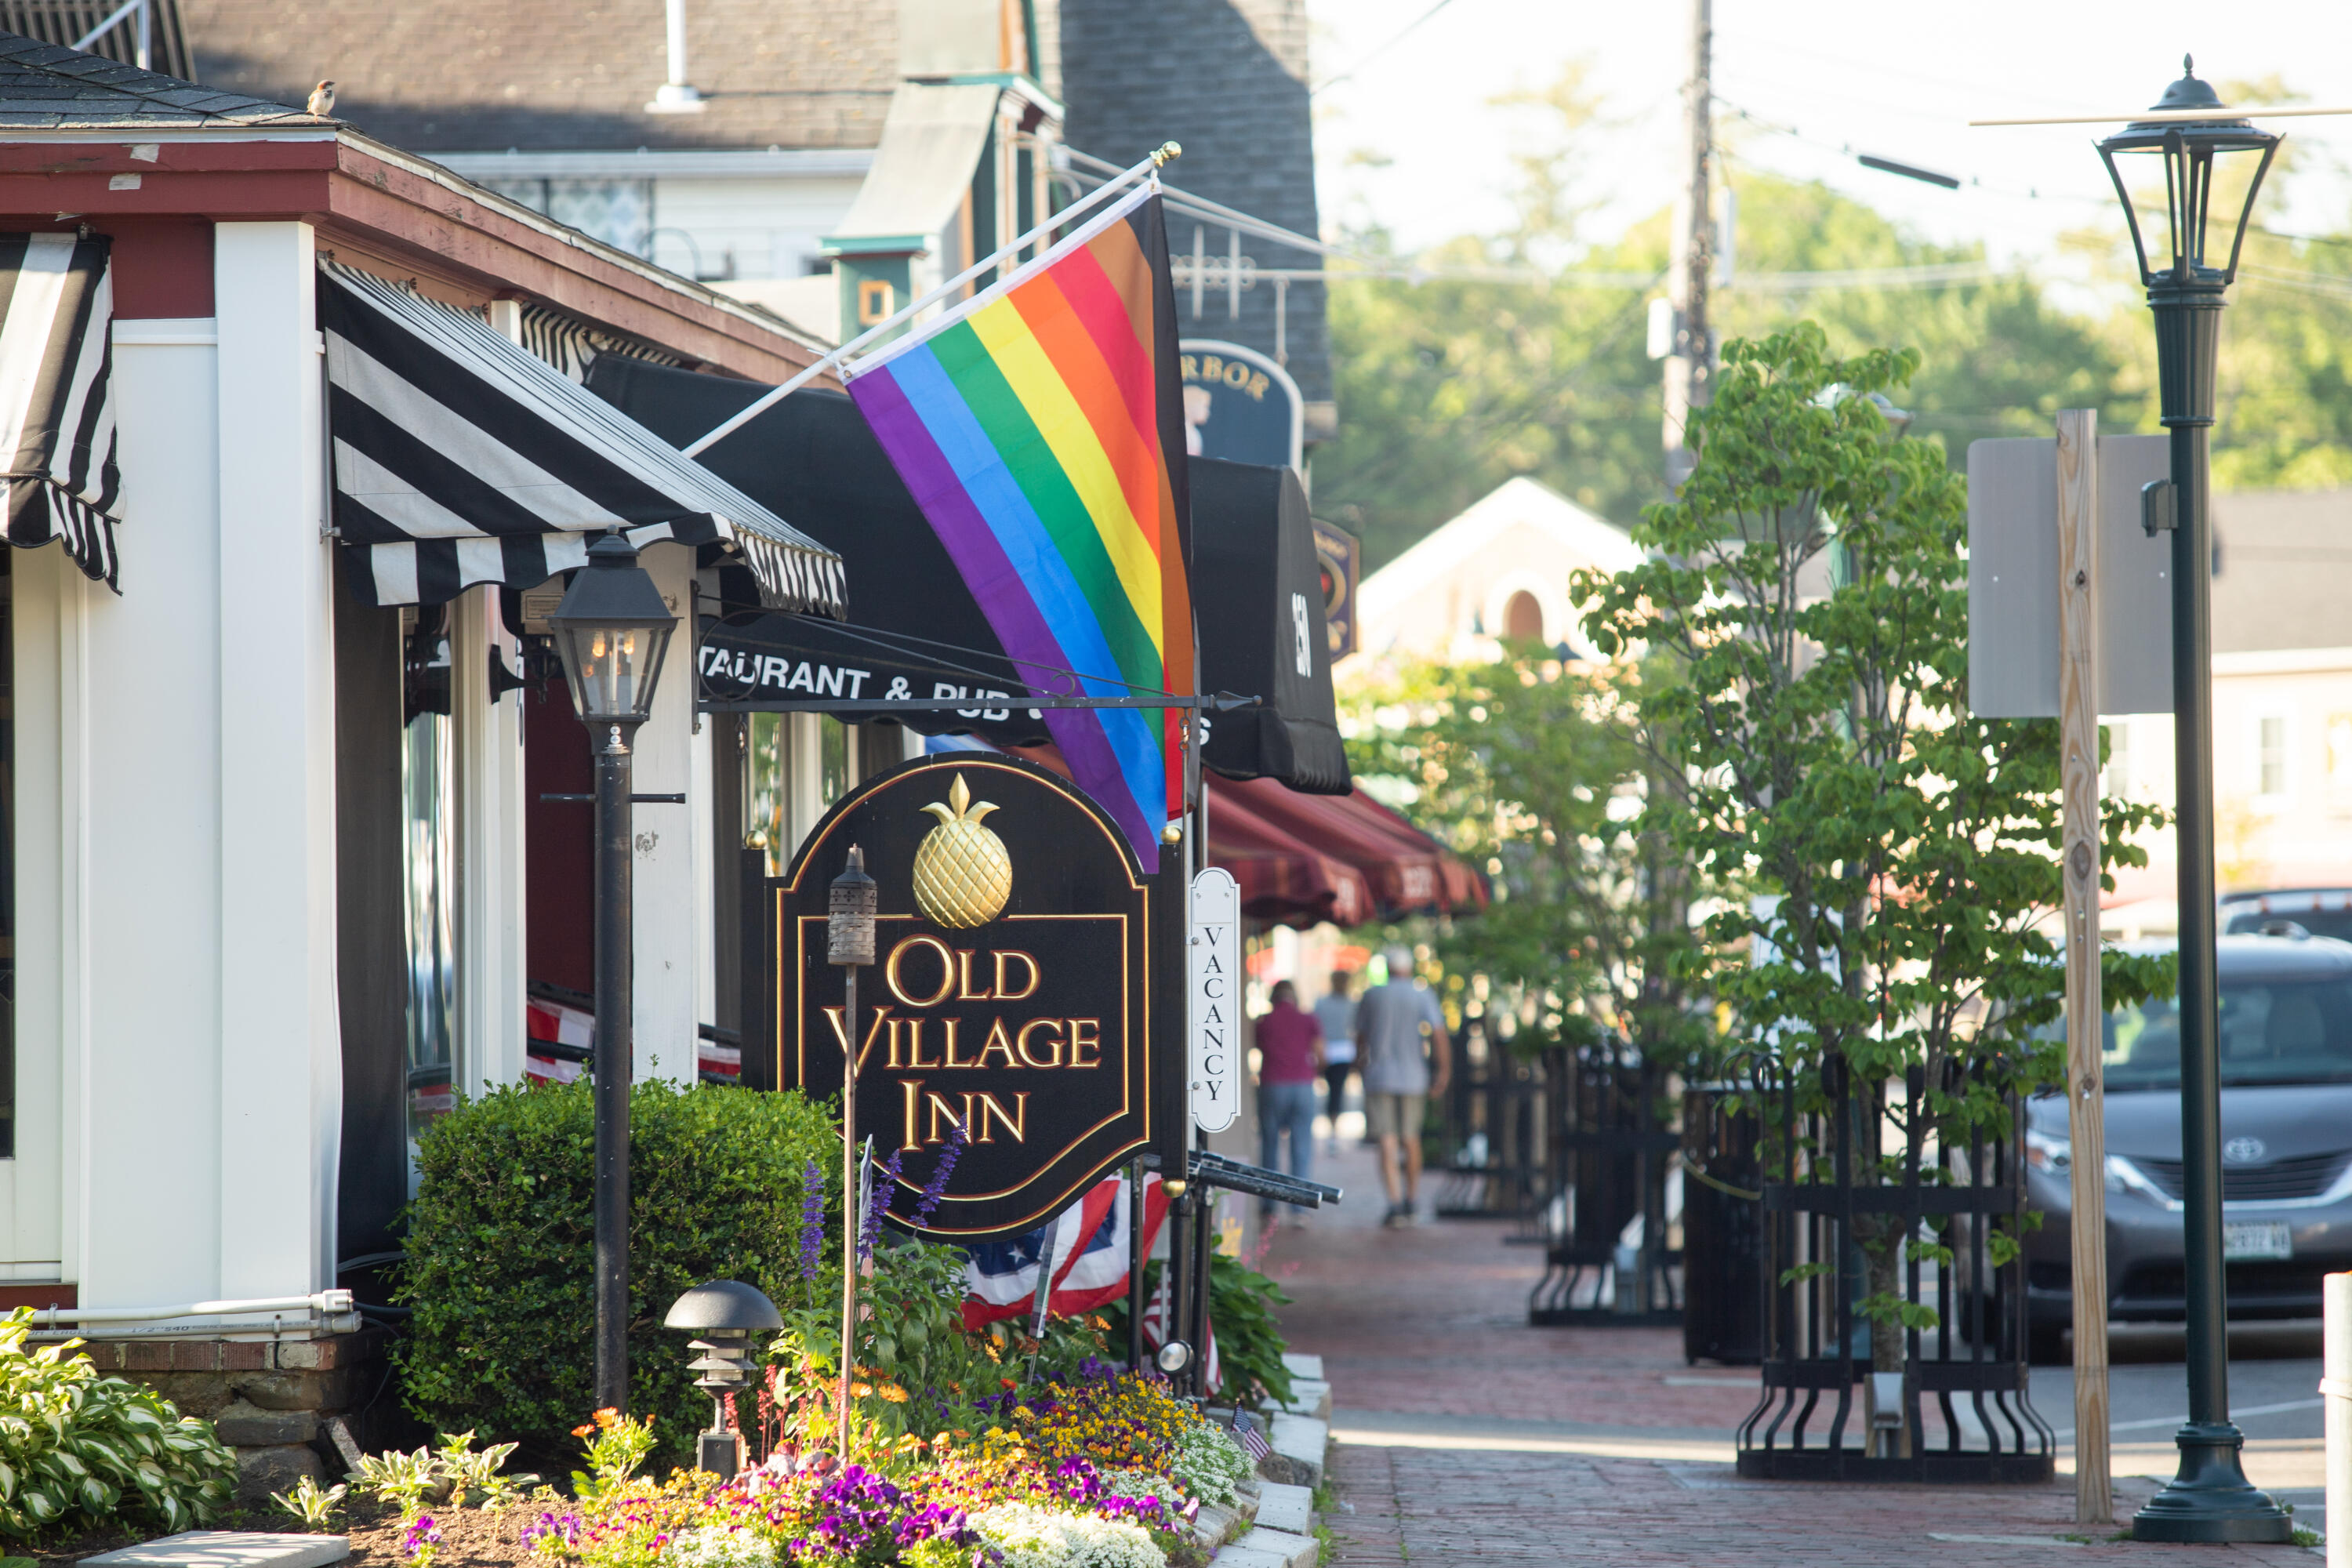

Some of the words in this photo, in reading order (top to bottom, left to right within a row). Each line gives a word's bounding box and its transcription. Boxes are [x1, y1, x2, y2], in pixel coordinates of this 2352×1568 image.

[698, 645, 871, 699] TAURANT
[931, 682, 1011, 721] PUB
[1203, 927, 1225, 1101] VACANCY
